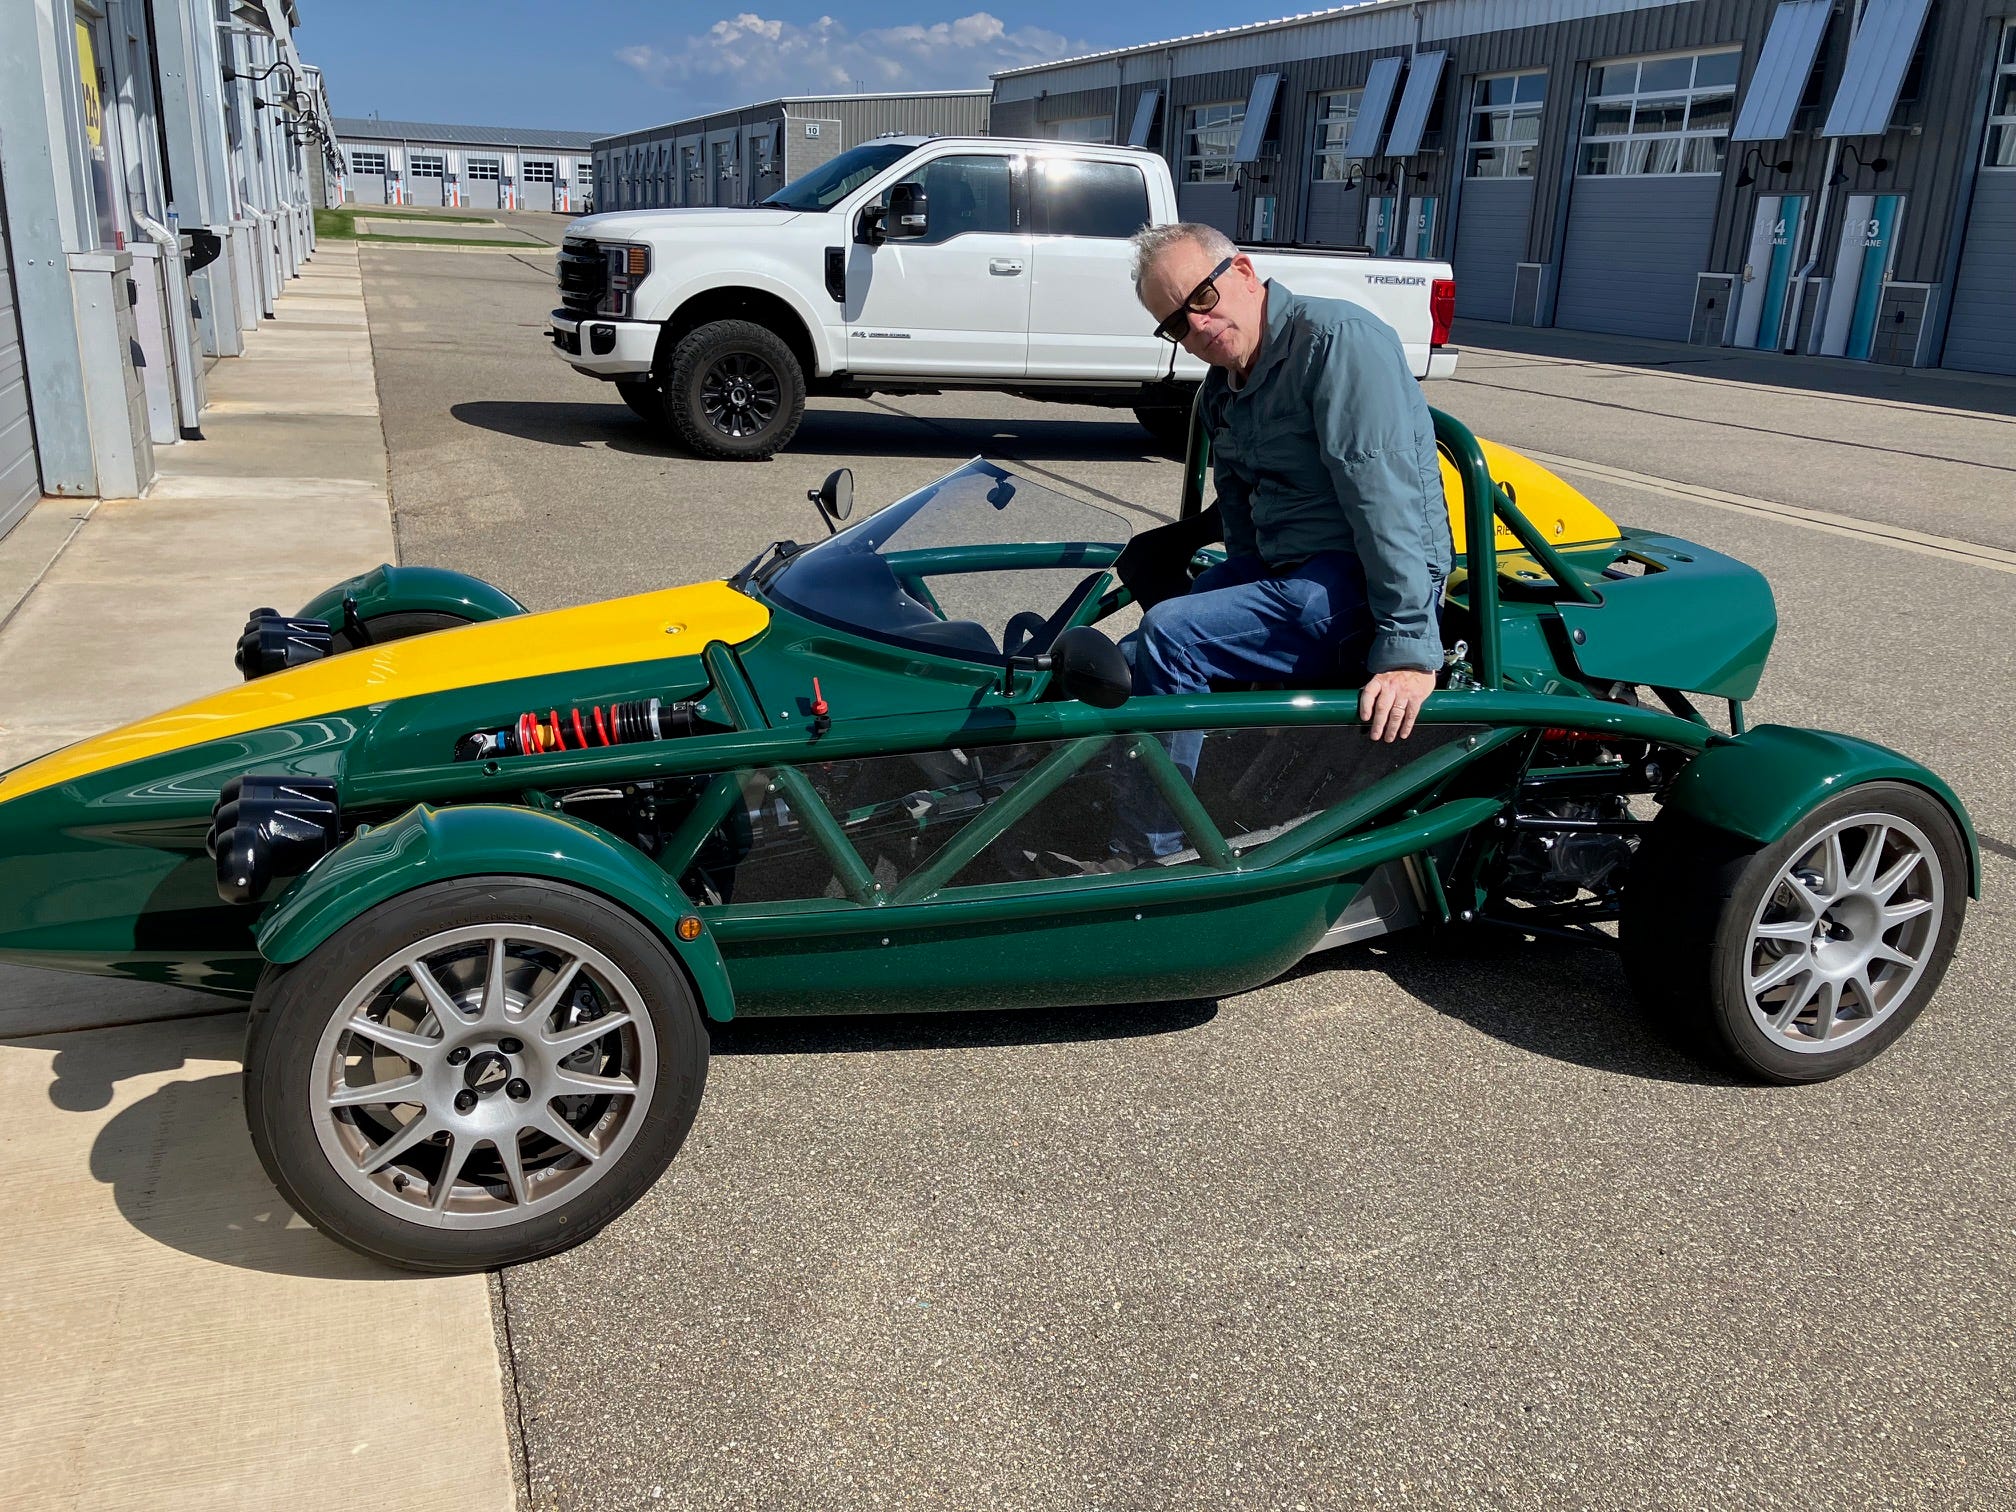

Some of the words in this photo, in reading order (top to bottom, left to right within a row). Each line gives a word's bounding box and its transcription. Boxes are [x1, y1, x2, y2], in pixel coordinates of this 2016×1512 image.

[808, 127, 818, 135] 10
[1758, 218, 1786, 236] 114
[1848, 219, 1880, 238] 113
[1768, 237, 1789, 246] LANE
[1859, 239, 1883, 248] LANE
[1364, 274, 1427, 286] TREMOR
[1495, 525, 1513, 536] RIE
